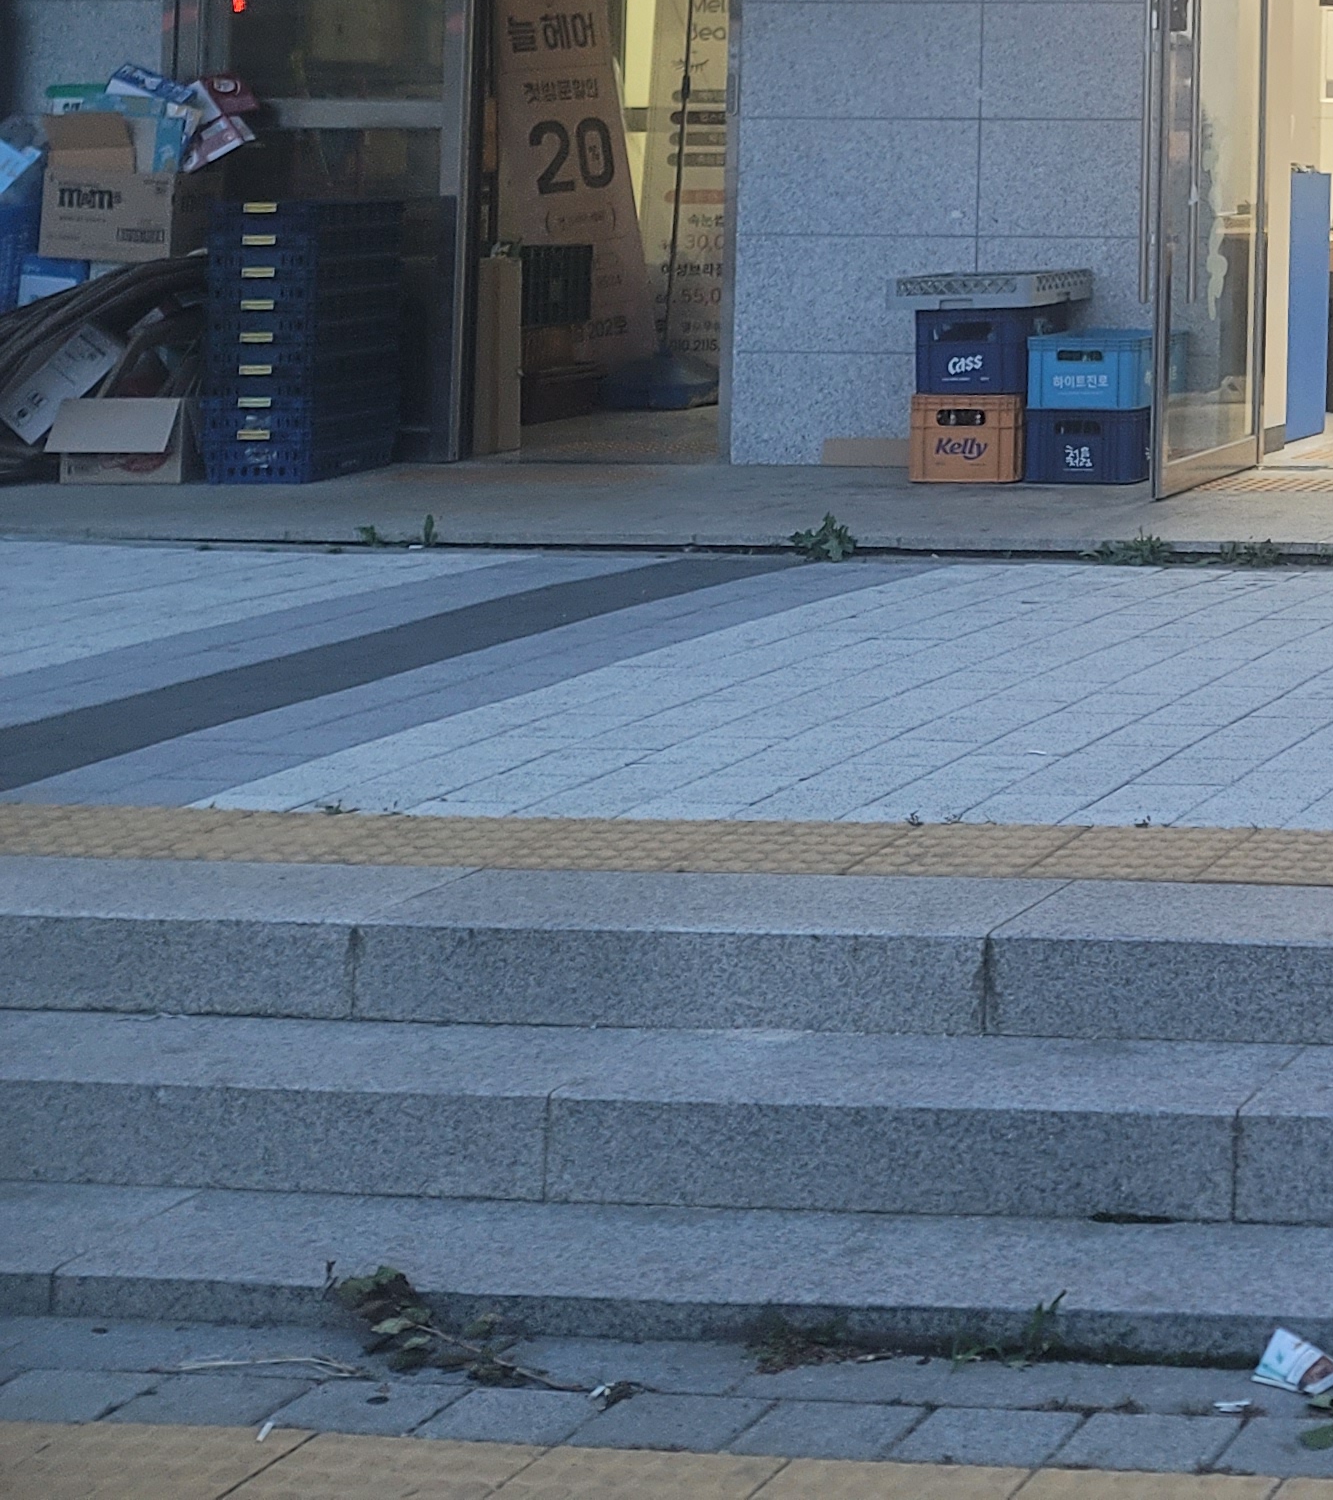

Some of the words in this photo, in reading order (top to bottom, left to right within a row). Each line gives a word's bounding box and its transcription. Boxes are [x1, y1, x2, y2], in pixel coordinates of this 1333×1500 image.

[529, 117, 615, 194] 20
[948, 355, 983, 375] Cass
[1053, 375, 1108, 388] 하이트진로
[934, 437, 987, 460] Kelly
